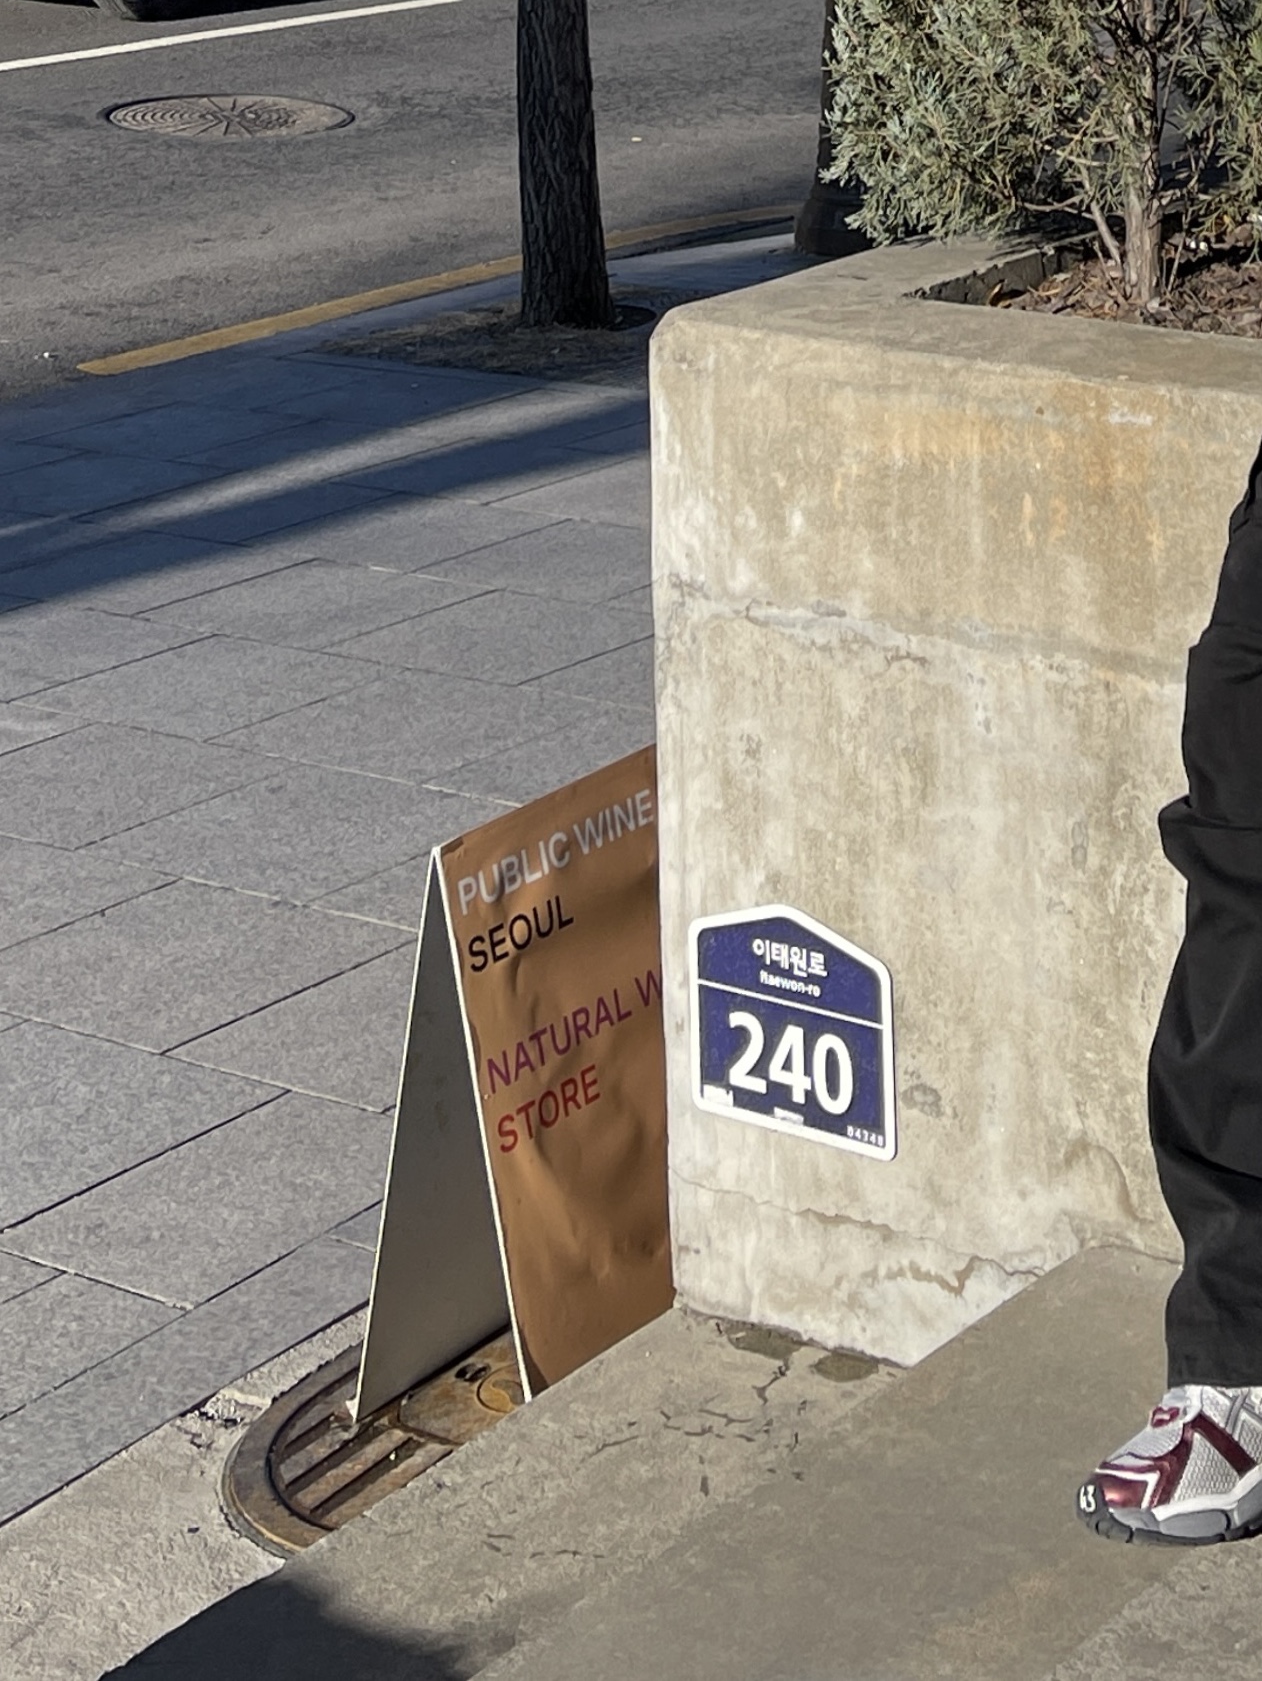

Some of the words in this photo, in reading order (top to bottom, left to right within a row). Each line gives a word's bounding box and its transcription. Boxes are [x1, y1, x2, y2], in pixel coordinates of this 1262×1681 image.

[458, 831, 570, 915] PUBLIC
[573, 788, 654, 855] WINE
[468, 896, 574, 972] SEOUL
[752, 938, 828, 978] 이태원로
[759, 969, 821, 998] Itaewon-ro
[487, 988, 632, 1094] NATURAL
[728, 1011, 853, 1115] 240
[497, 1064, 600, 1153] STORE
[1080, 1484, 1096, 1513] 43
